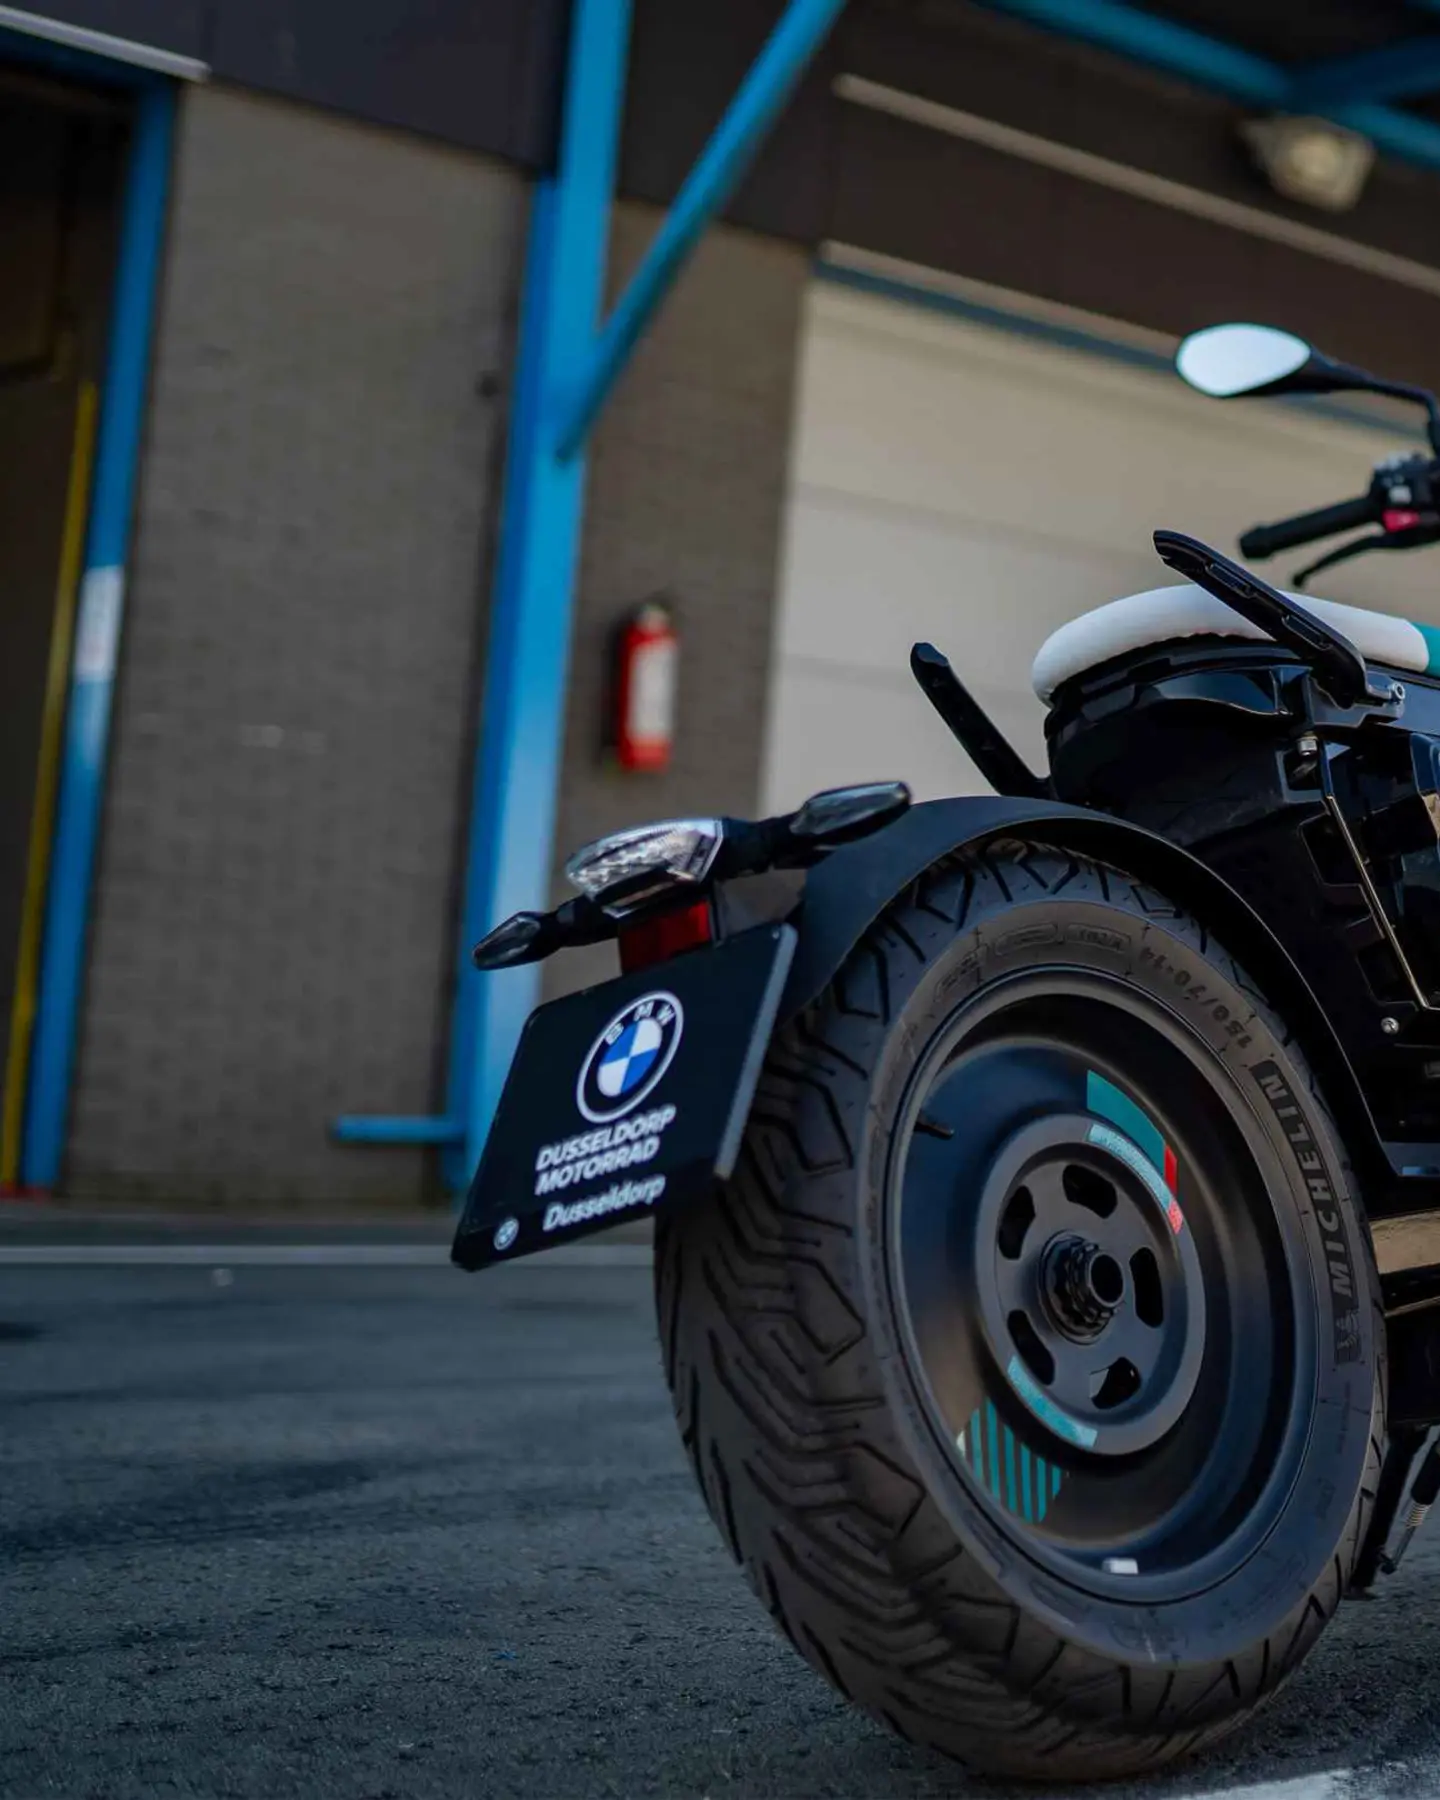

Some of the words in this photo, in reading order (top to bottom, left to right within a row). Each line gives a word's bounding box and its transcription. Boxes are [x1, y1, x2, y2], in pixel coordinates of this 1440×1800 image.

[605, 1001, 676, 1046] BMW
[534, 1136, 660, 1196] MOTORRAD
[535, 1104, 677, 1171] DUSSELDORP
[542, 1174, 666, 1232] Dusseldorp
[1260, 1074, 1352, 1298] MICHELIN
